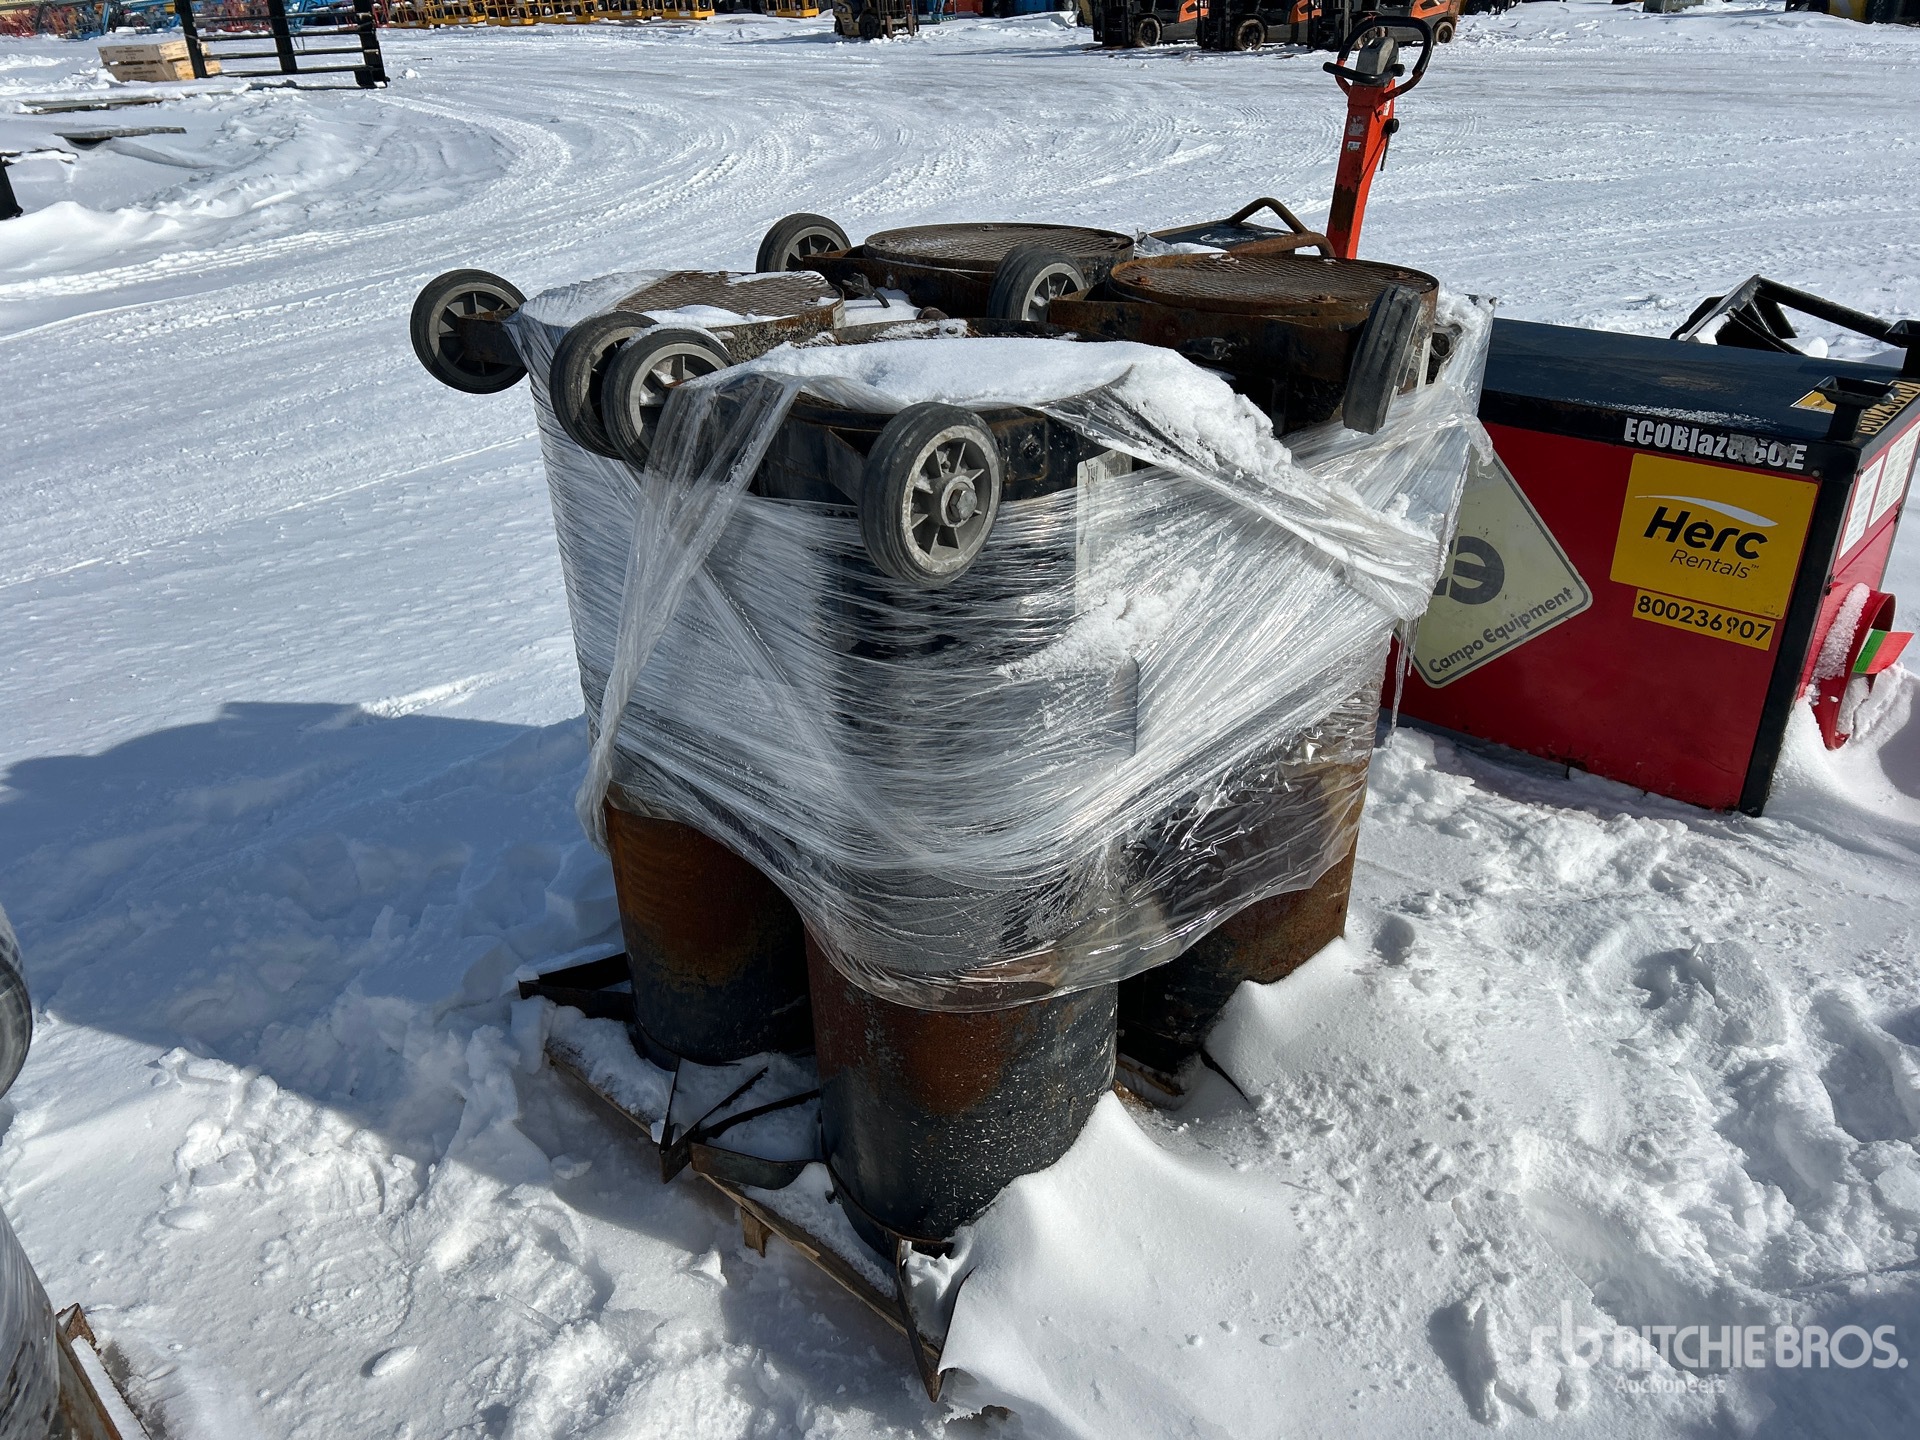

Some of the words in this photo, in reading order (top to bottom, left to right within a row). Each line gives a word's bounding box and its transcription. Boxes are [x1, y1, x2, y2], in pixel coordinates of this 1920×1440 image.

[1643, 506, 1768, 560] Herc
[1429, 639, 1484, 673] Campo
[1482, 587, 1574, 643] Equipment
[1637, 595, 1772, 642] 800236907
